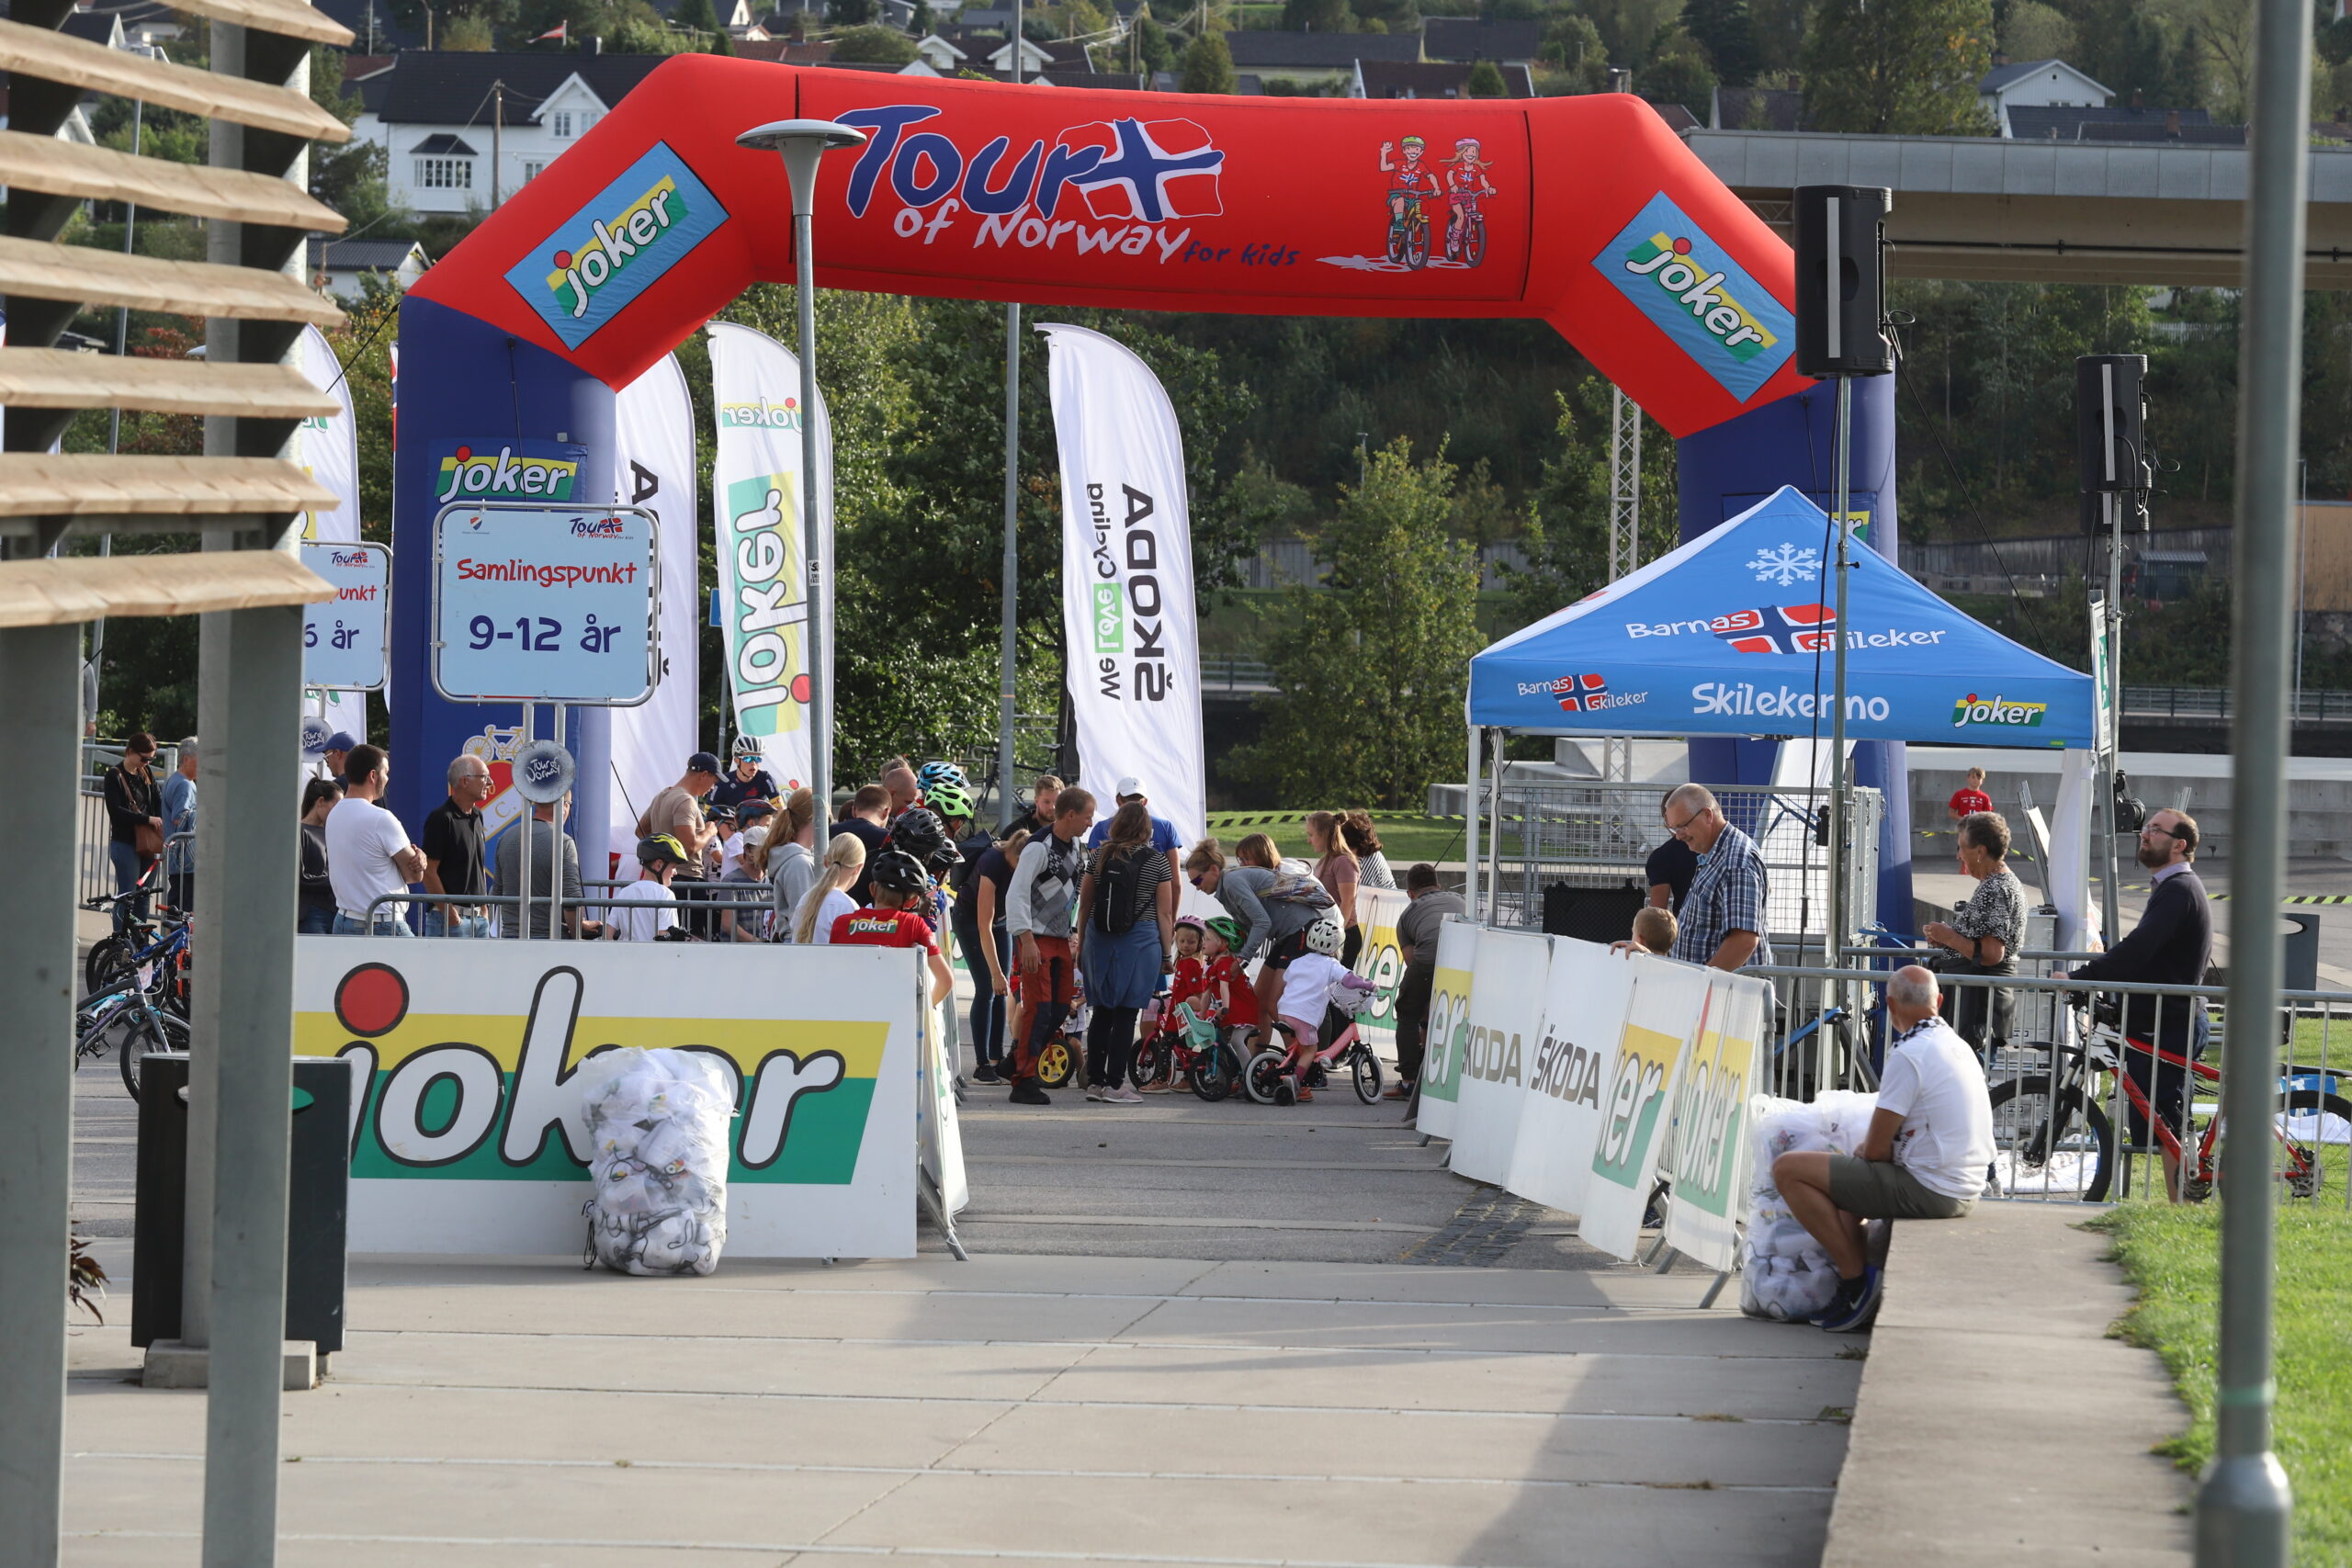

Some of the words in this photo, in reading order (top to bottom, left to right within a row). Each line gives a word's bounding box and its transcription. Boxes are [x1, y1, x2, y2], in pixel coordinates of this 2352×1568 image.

[832, 104, 1105, 220] Tour
[894, 197, 959, 239] of
[974, 201, 1192, 265] Norway
[1183, 239, 1232, 263] for
[1239, 243, 1302, 267] kids
[553, 188, 670, 318] joker
[1624, 236, 1764, 350] joker
[439, 445, 570, 502] joker
[569, 517, 608, 535] Tour
[457, 558, 637, 588] Samlingspunkt
[331, 620, 359, 649] år
[469, 615, 562, 651] 9-12
[580, 613, 621, 653] år
[1625, 612, 1750, 639] Barnas
[1518, 676, 1569, 696] Barnas
[1591, 691, 1648, 711] skileker
[1954, 693, 2041, 728] joker
[849, 917, 895, 936] joker
[1530, 1023, 1601, 1111] ŠKODA
